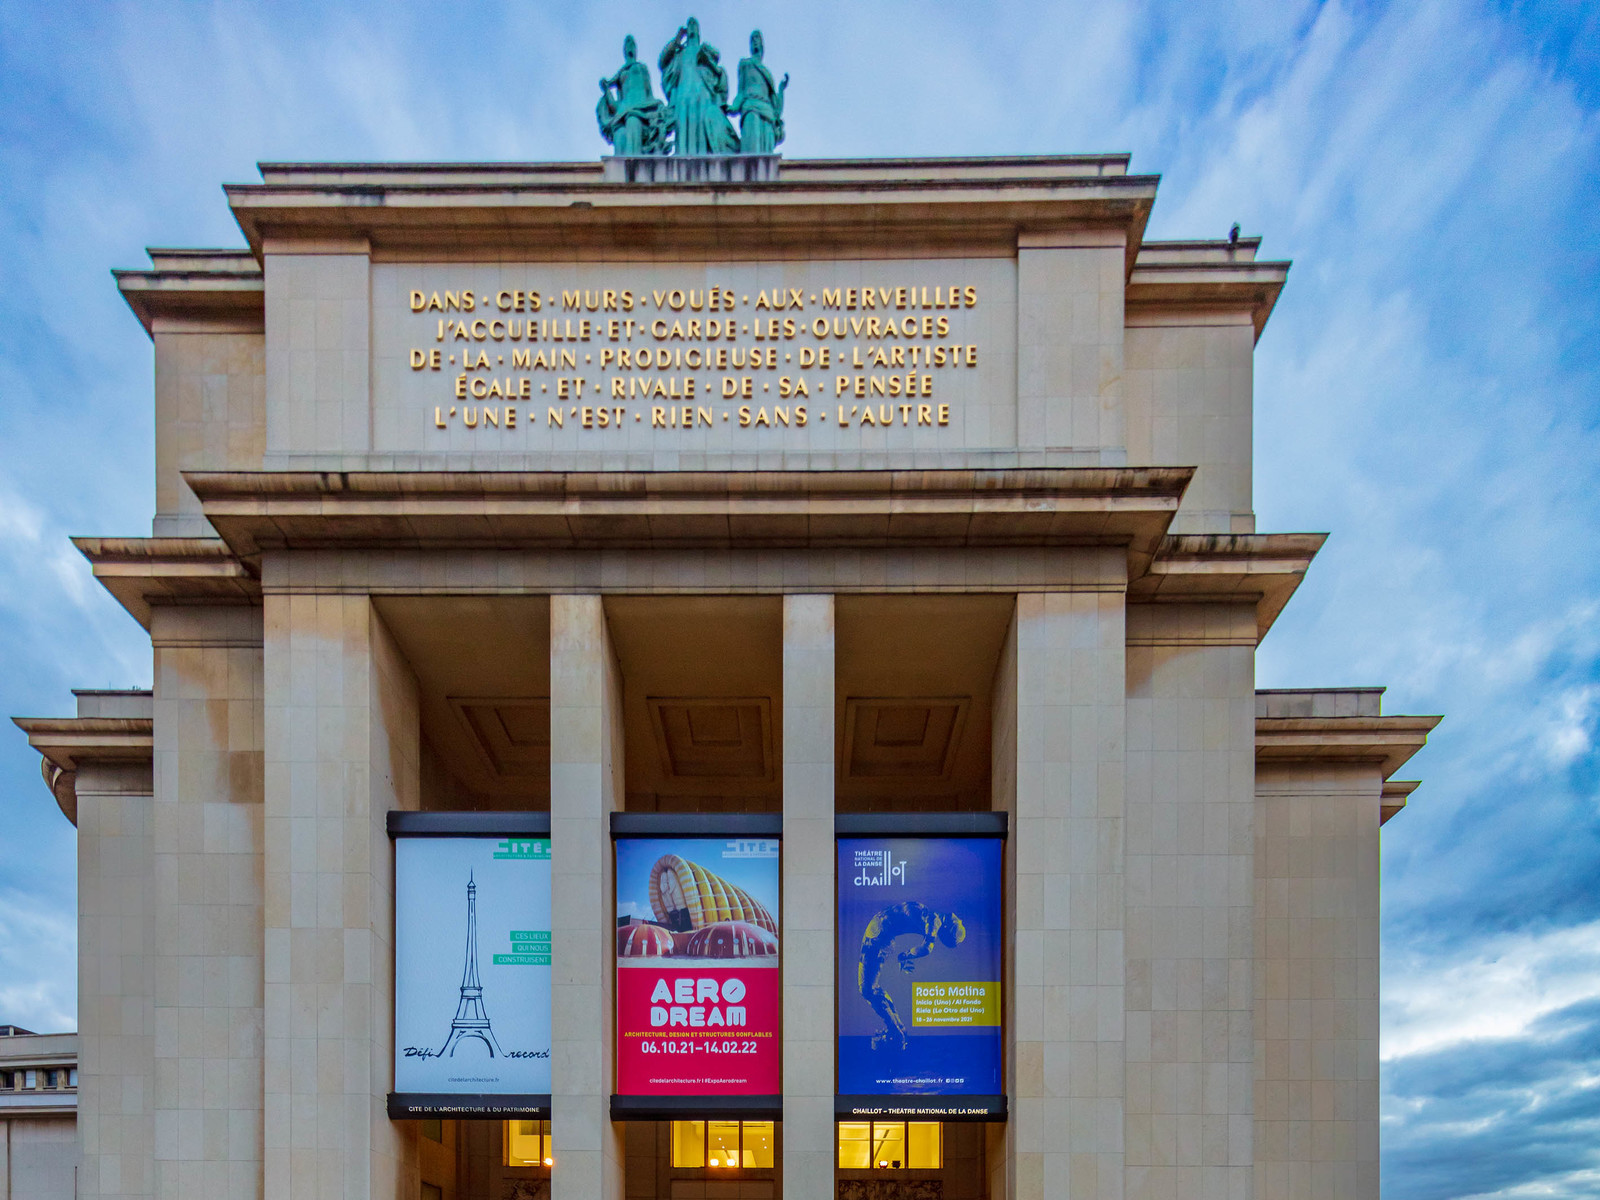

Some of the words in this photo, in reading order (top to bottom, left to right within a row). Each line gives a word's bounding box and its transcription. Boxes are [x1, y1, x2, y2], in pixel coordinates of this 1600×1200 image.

[409, 289, 477, 314] DANS
[495, 288, 543, 313] CES
[561, 288, 636, 312] MURS
[652, 284, 737, 313] VOUÉS
[754, 287, 805, 311] AUX
[821, 285, 978, 311] MERVEILLES
[435, 318, 592, 343] J'ACCUEILLE
[607, 318, 636, 340] ET
[650, 317, 738, 342] GARDE
[753, 317, 797, 340] LES
[811, 315, 951, 341] OUVRAGES
[409, 348, 442, 371] DE
[462, 348, 492, 371] LA
[511, 347, 578, 371] MAIN
[599, 346, 778, 371] PRODIGIEUSE
[798, 346, 831, 370] DE
[852, 344, 979, 368] L'ARTISTE
[454, 373, 532, 398] ÉGALE
[557, 377, 585, 398] ET
[610, 376, 696, 399] RIVALE
[721, 376, 754, 398] DE
[778, 376, 810, 398] SA
[835, 370, 934, 398] PENSÉE
[434, 406, 518, 428] L'UNE
[547, 405, 626, 428] N'EST
[651, 405, 714, 428] RIEN
[738, 404, 809, 427] SANS
[837, 403, 951, 428] L'AUTRE
[515, 932, 528, 940] CES
[650, 978, 747, 1004] AERO
[948, 985, 986, 997] Molina
[650, 1006, 747, 1027] DREAM
